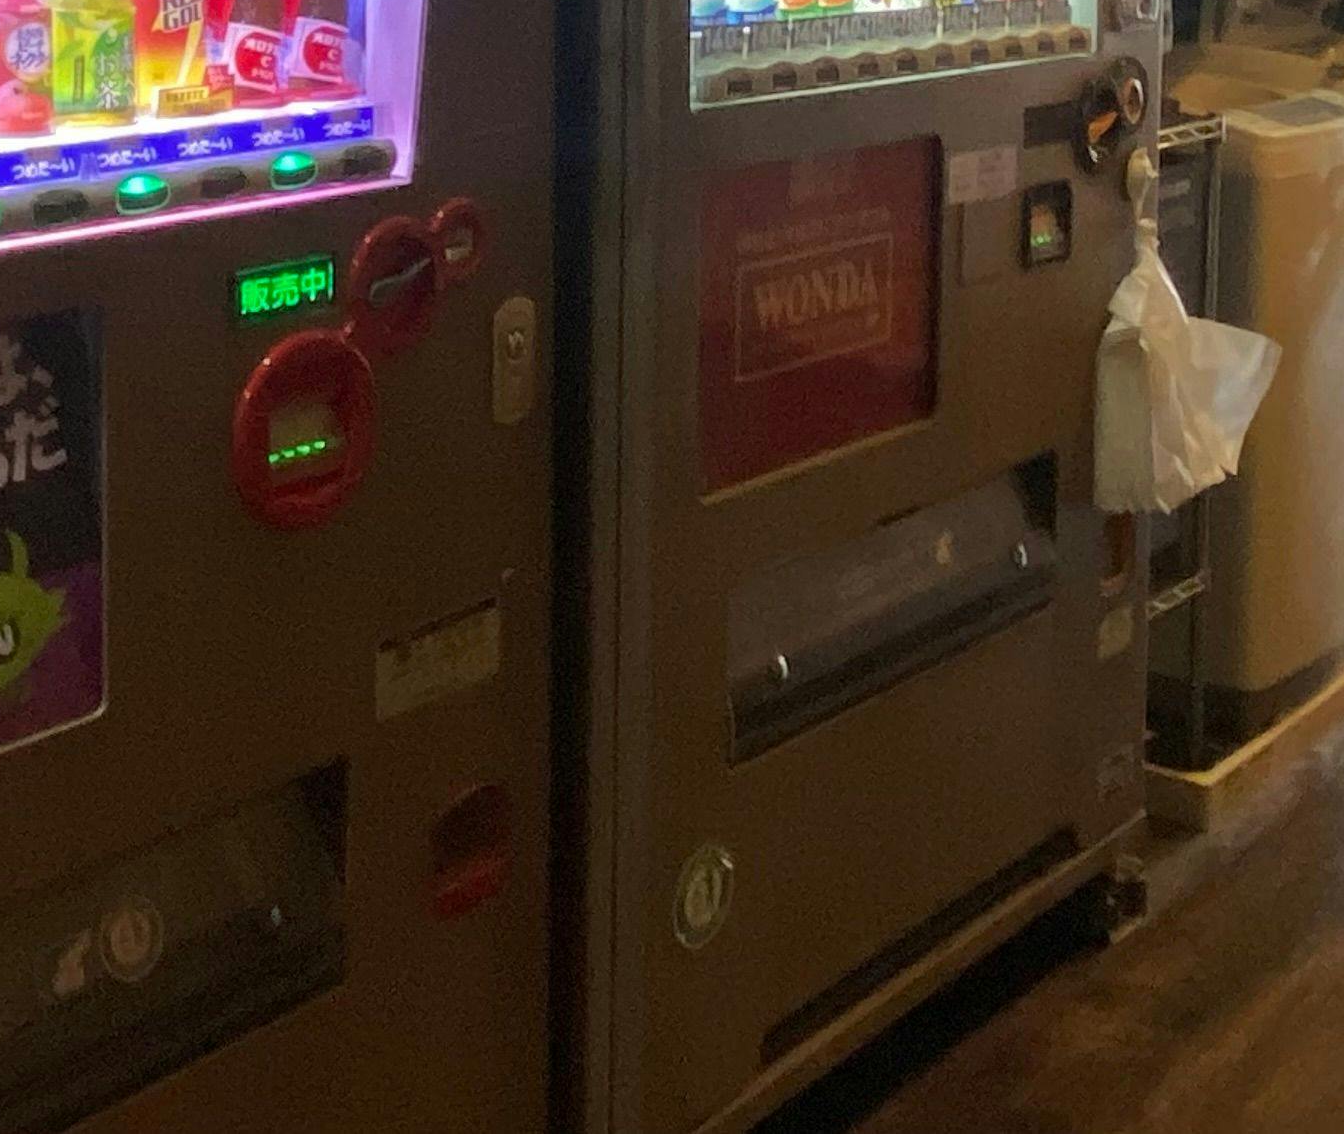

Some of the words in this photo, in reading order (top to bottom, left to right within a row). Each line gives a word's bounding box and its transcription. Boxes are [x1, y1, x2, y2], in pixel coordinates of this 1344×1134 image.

[240, 266, 327, 314] 販売中
[758, 260, 879, 329] WONDA
